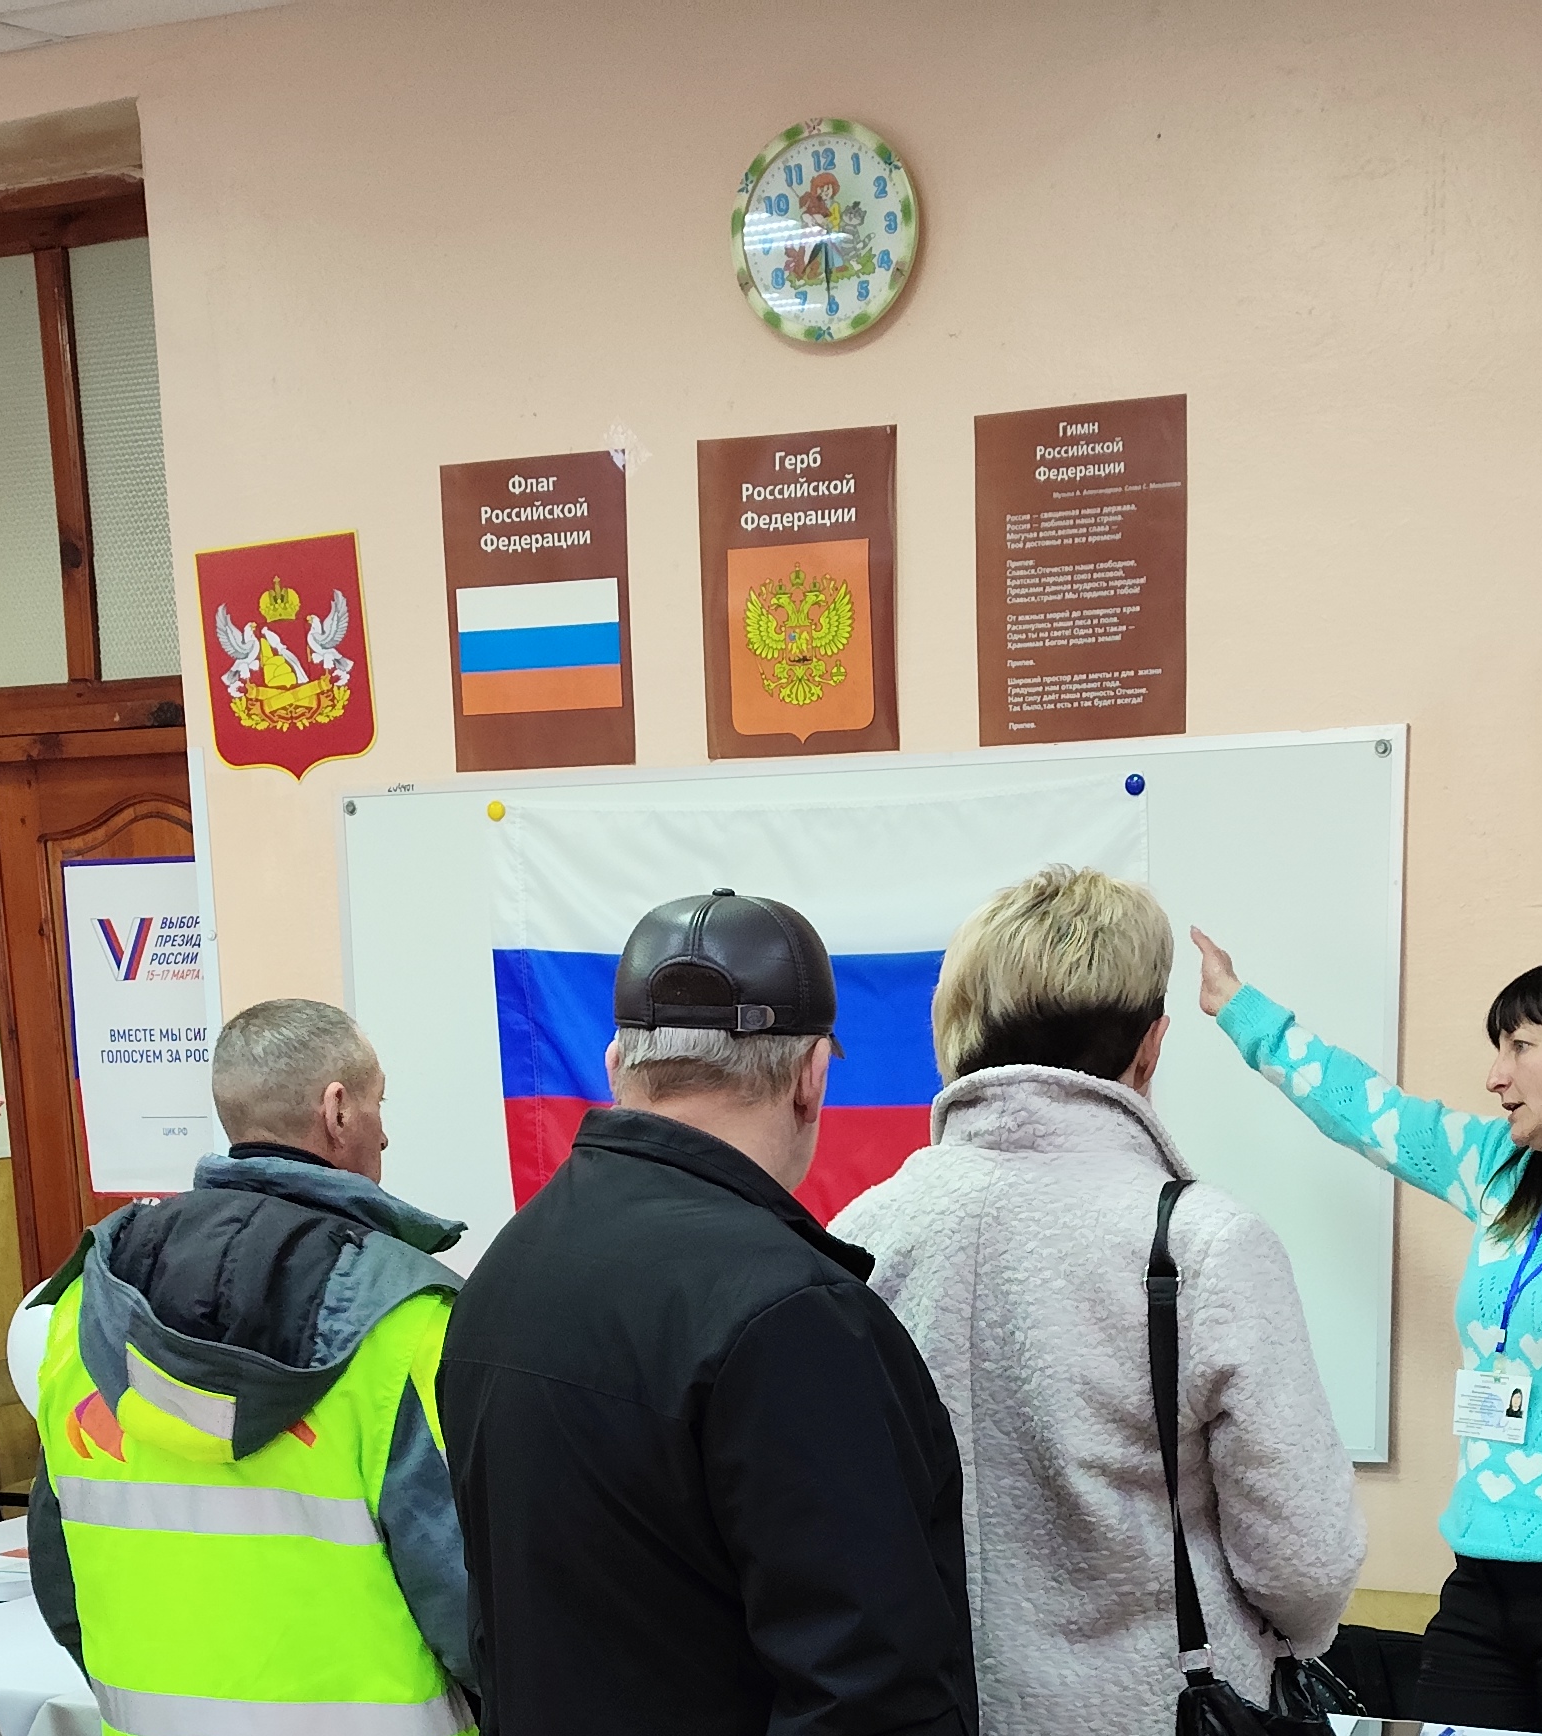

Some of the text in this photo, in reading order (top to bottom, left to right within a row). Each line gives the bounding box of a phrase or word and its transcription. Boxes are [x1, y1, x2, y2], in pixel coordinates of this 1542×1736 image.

[811, 147, 837, 172] 12
[851, 153, 862, 175] 1
[784, 163, 803, 187] 11
[873, 176, 888, 199] 2
[764, 193, 789, 217] 10
[884, 211, 898, 234] 3
[877, 249, 894, 272] 4
[771, 267, 786, 290] 8
[795, 291, 808, 312] 7
[857, 280, 870, 301] 5
[826, 295, 839, 316] 6
[1059, 421, 1099, 437] Гимн
[1036, 437, 1123, 461] Российской
[775, 447, 821, 474] Герб
[1035, 461, 1125, 482] Федерации
[508, 474, 557, 495] Флаг
[741, 473, 855, 502] Российской
[480, 497, 588, 524] Российской
[740, 507, 856, 531] Федерации
[480, 530, 591, 553] Федерации
[160, 916, 201, 929] ВЫБОР
[155, 934, 201, 948] ПРЕЗИД
[149, 951, 199, 965] РОССИИ
[171, 969, 200, 981] МАРТА
[109, 1027, 208, 1044] ВМЕСТЕ МЫ СИЛ
[100, 1048, 209, 1064] ГОЛОСУЕМ ЗА РОС
